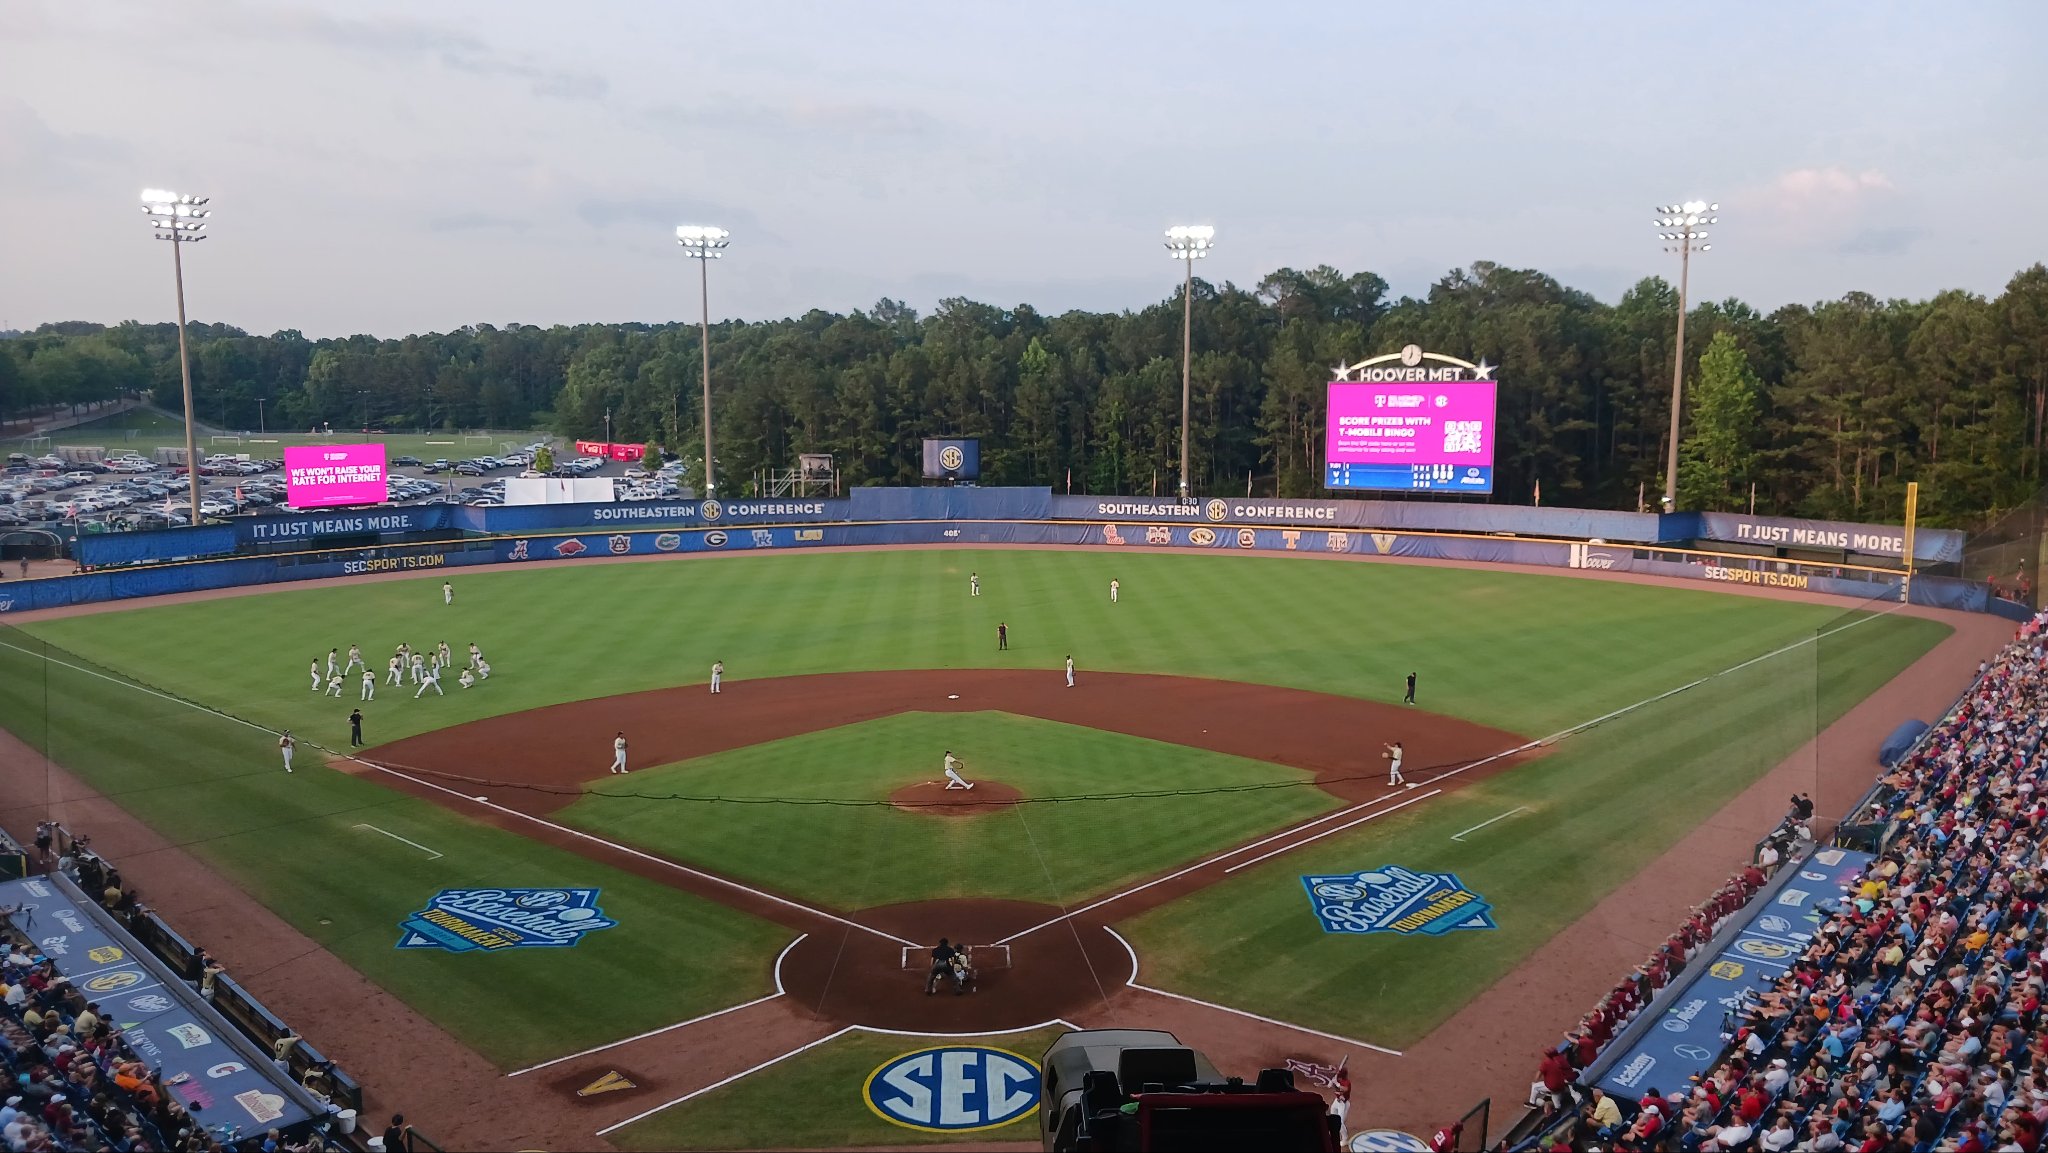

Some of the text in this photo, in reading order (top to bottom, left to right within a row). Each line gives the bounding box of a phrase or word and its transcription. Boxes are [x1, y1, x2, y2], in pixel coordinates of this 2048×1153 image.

[1360, 367, 1464, 381] HOOVER MET
[1339, 416, 1370, 426] SCORE
[1405, 416, 1431, 426] WITH
[941, 449, 960, 468] SEC
[291, 464, 381, 477] WE WON'T RAISE YOUR
[292, 473, 381, 486] RATE FOR INTERNET
[593, 506, 695, 520] SOUTHEASTERN
[1098, 503, 1200, 516] SOUTHEASTERN
[253, 515, 413, 538] IT JUST MEANS MORE.
[795, 529, 824, 542] LSU
[1738, 523, 1752, 538] IT
[1753, 525, 1790, 541] JUST
[1792, 528, 1848, 547] MEANS
[344, 554, 445, 574] SECSPORTS.COM
[1705, 565, 1808, 589] SECSPORTS.COM
[1321, 866, 1436, 931] Baseball
[436, 889, 611, 939] Baseball
[1388, 890, 1477, 932] TOURNAMENT
[418, 908, 515, 949] TOURNAMENT
[882, 1051, 1035, 1125] SEC
